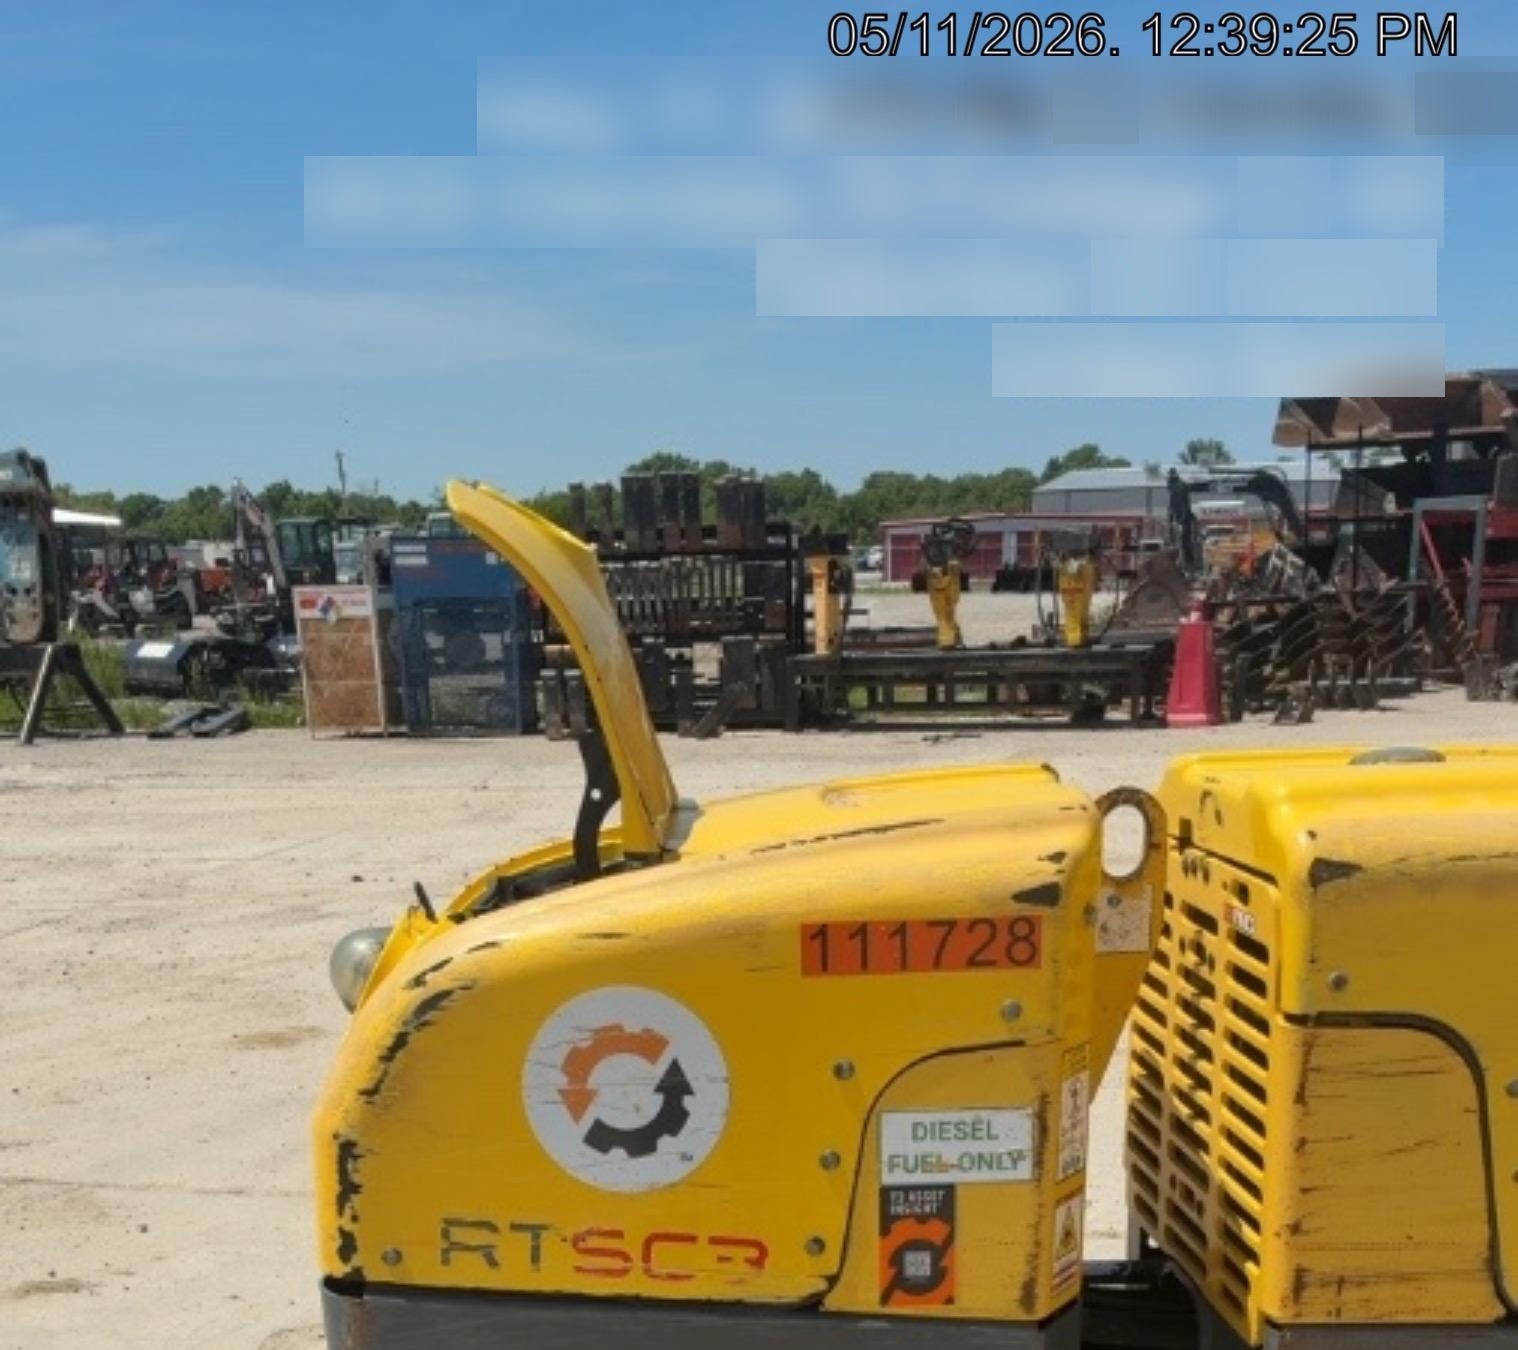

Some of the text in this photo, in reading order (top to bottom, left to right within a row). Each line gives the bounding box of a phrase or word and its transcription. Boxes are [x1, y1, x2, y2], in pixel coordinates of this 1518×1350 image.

[809, 916, 1039, 973] 111728
[911, 1118, 999, 1143] DIESEL
[887, 1149, 1023, 1175] FUEL ONLY
